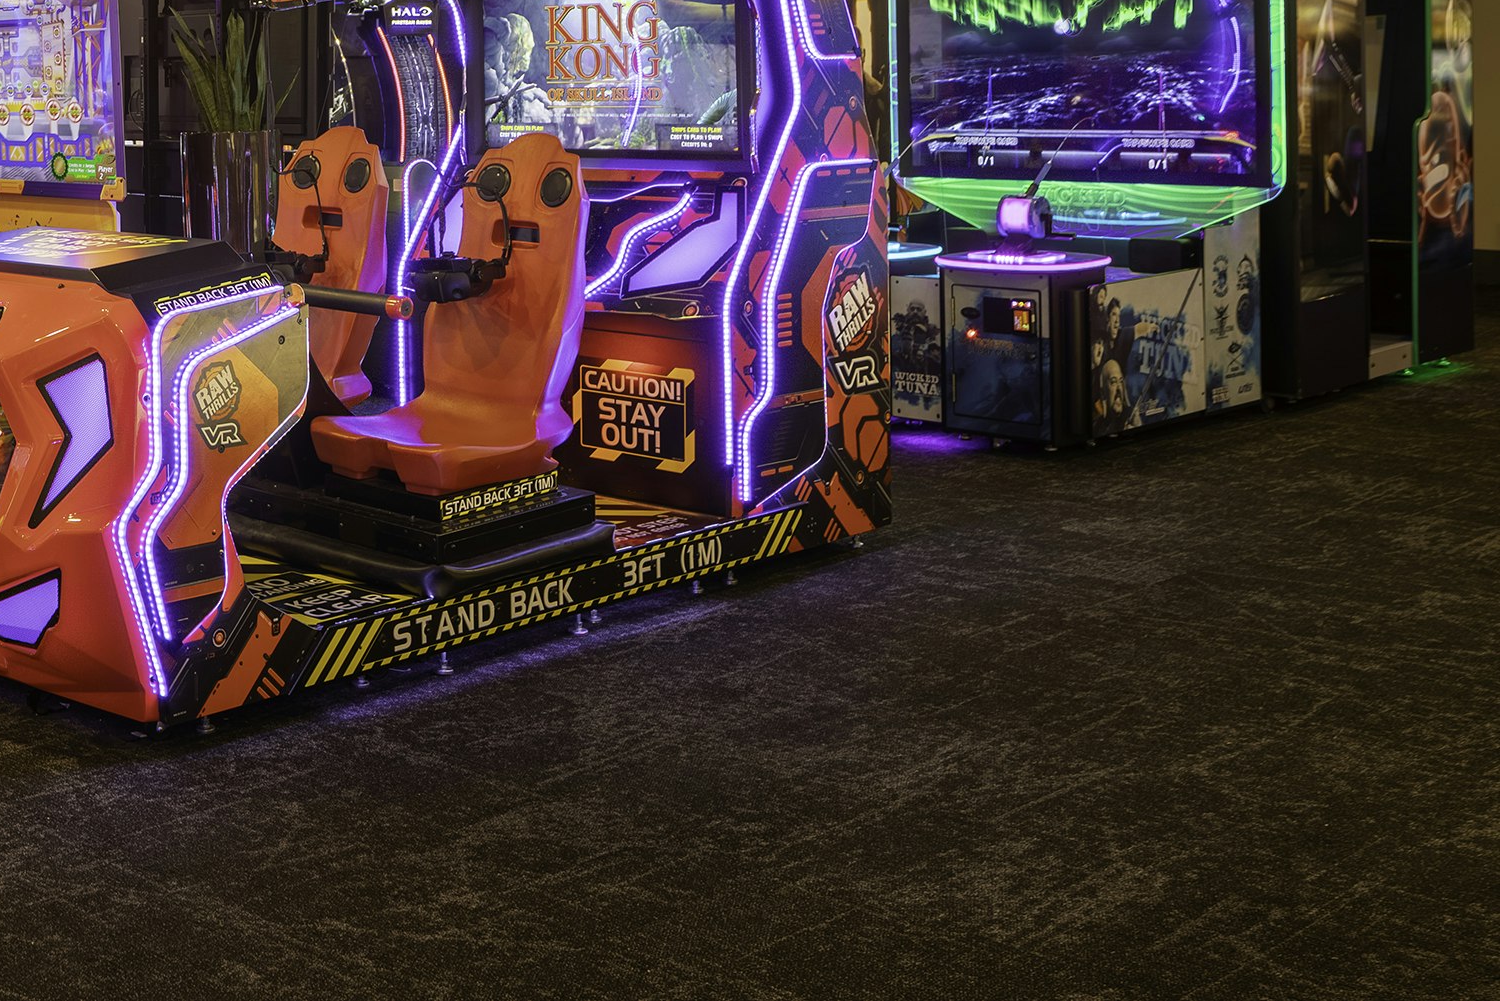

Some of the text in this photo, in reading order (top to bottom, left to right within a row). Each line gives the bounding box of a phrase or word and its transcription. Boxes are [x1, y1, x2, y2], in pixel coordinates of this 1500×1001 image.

[391, 6, 432, 17] HALO
[544, 0, 661, 45] KING
[545, 42, 661, 80] KONG
[547, 87, 663, 101] OF SKULL ISLND
[98, 165, 114, 173] Player
[977, 155, 995, 166] 0/1
[1148, 159, 1167, 169] 0/1
[157, 276, 272, 313] STAND BACK 3FT (1M)
[829, 272, 870, 339] RAW
[836, 296, 876, 352] THRILLS
[196, 365, 235, 410] RAW
[584, 370, 681, 401] CAUTION!
[835, 356, 880, 390] VR
[895, 371, 940, 384] WICKED
[895, 380, 940, 396] TUNA
[202, 381, 239, 420] THRILLS
[598, 397, 667, 429] STAY
[201, 422, 241, 447] VR
[601, 422, 661, 454] OUT!
[445, 475, 555, 516] STAND BACK 3FT (1M)
[246, 578, 291, 592] NO
[284, 588, 352, 610] KEEP
[392, 536, 722, 652] STAND BACK 3FT (1M)
[303, 593, 392, 618] CLEAR
